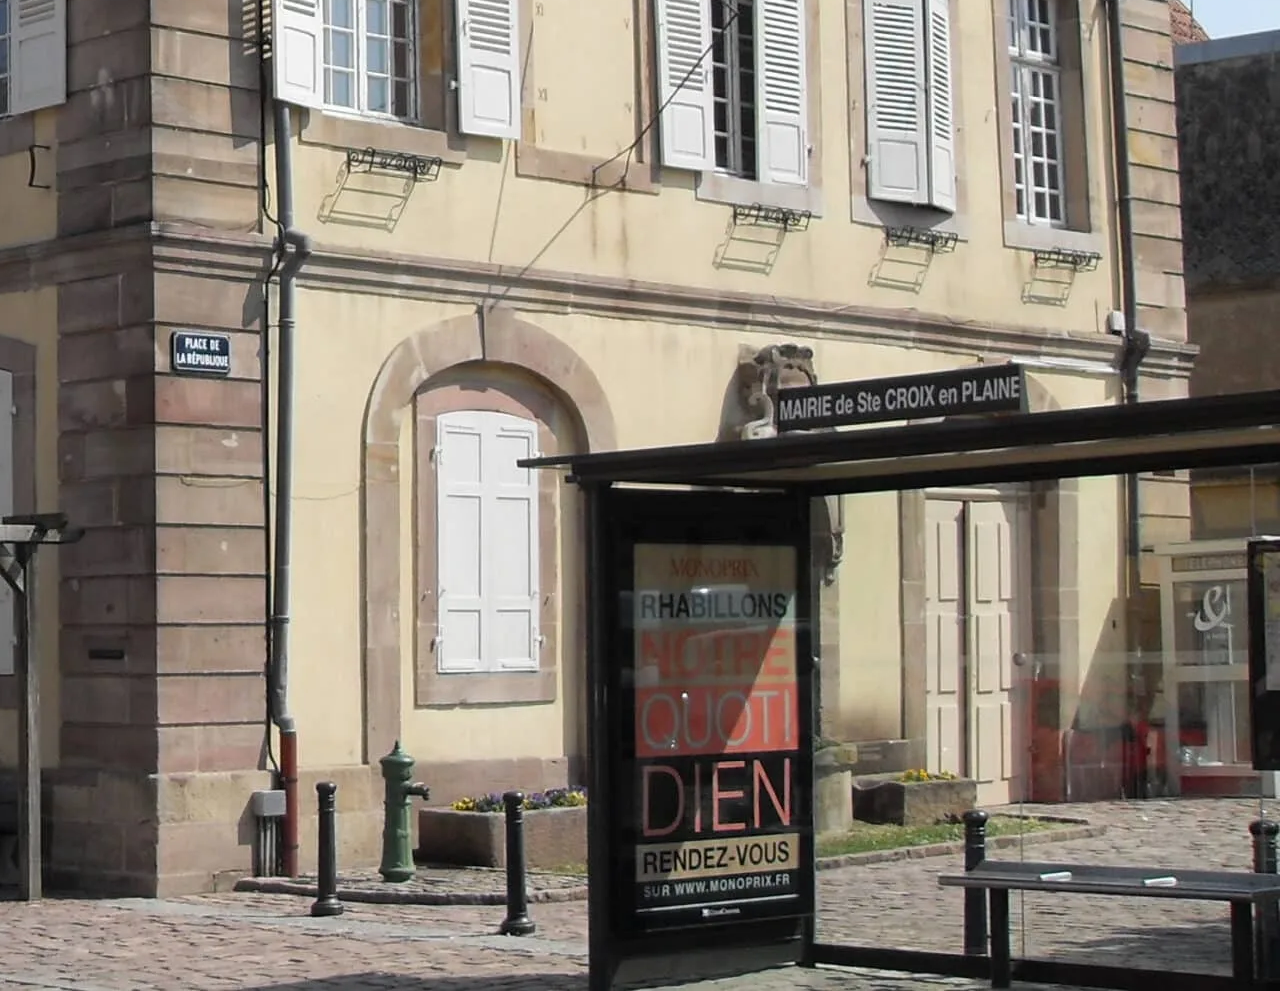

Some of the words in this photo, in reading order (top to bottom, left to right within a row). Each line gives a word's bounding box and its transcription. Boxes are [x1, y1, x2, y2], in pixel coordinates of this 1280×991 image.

[176, 352, 186, 364] LA
[187, 351, 229, 367] RÉPUBLIQUE
[185, 337, 208, 350] PLACE
[210, 339, 220, 351] DE
[780, 395, 832, 420] MAIRIE
[835, 394, 853, 414] de
[857, 391, 881, 413] Ste
[885, 385, 936, 409] CROIX
[939, 388, 958, 405] en
[962, 376, 1021, 402] PLAINE
[671, 557, 760, 579] MONOPRIX
[641, 593, 788, 619] RHABILLONS
[641, 627, 790, 680] NOTRE
[641, 688, 791, 750] QUOTI
[642, 757, 791, 837] DIEN
[643, 840, 790, 875] RENDEZ-VOUS
[643, 883, 670, 898] SUR
[674, 872, 790, 896] WWW.MONOPRIX.FR
